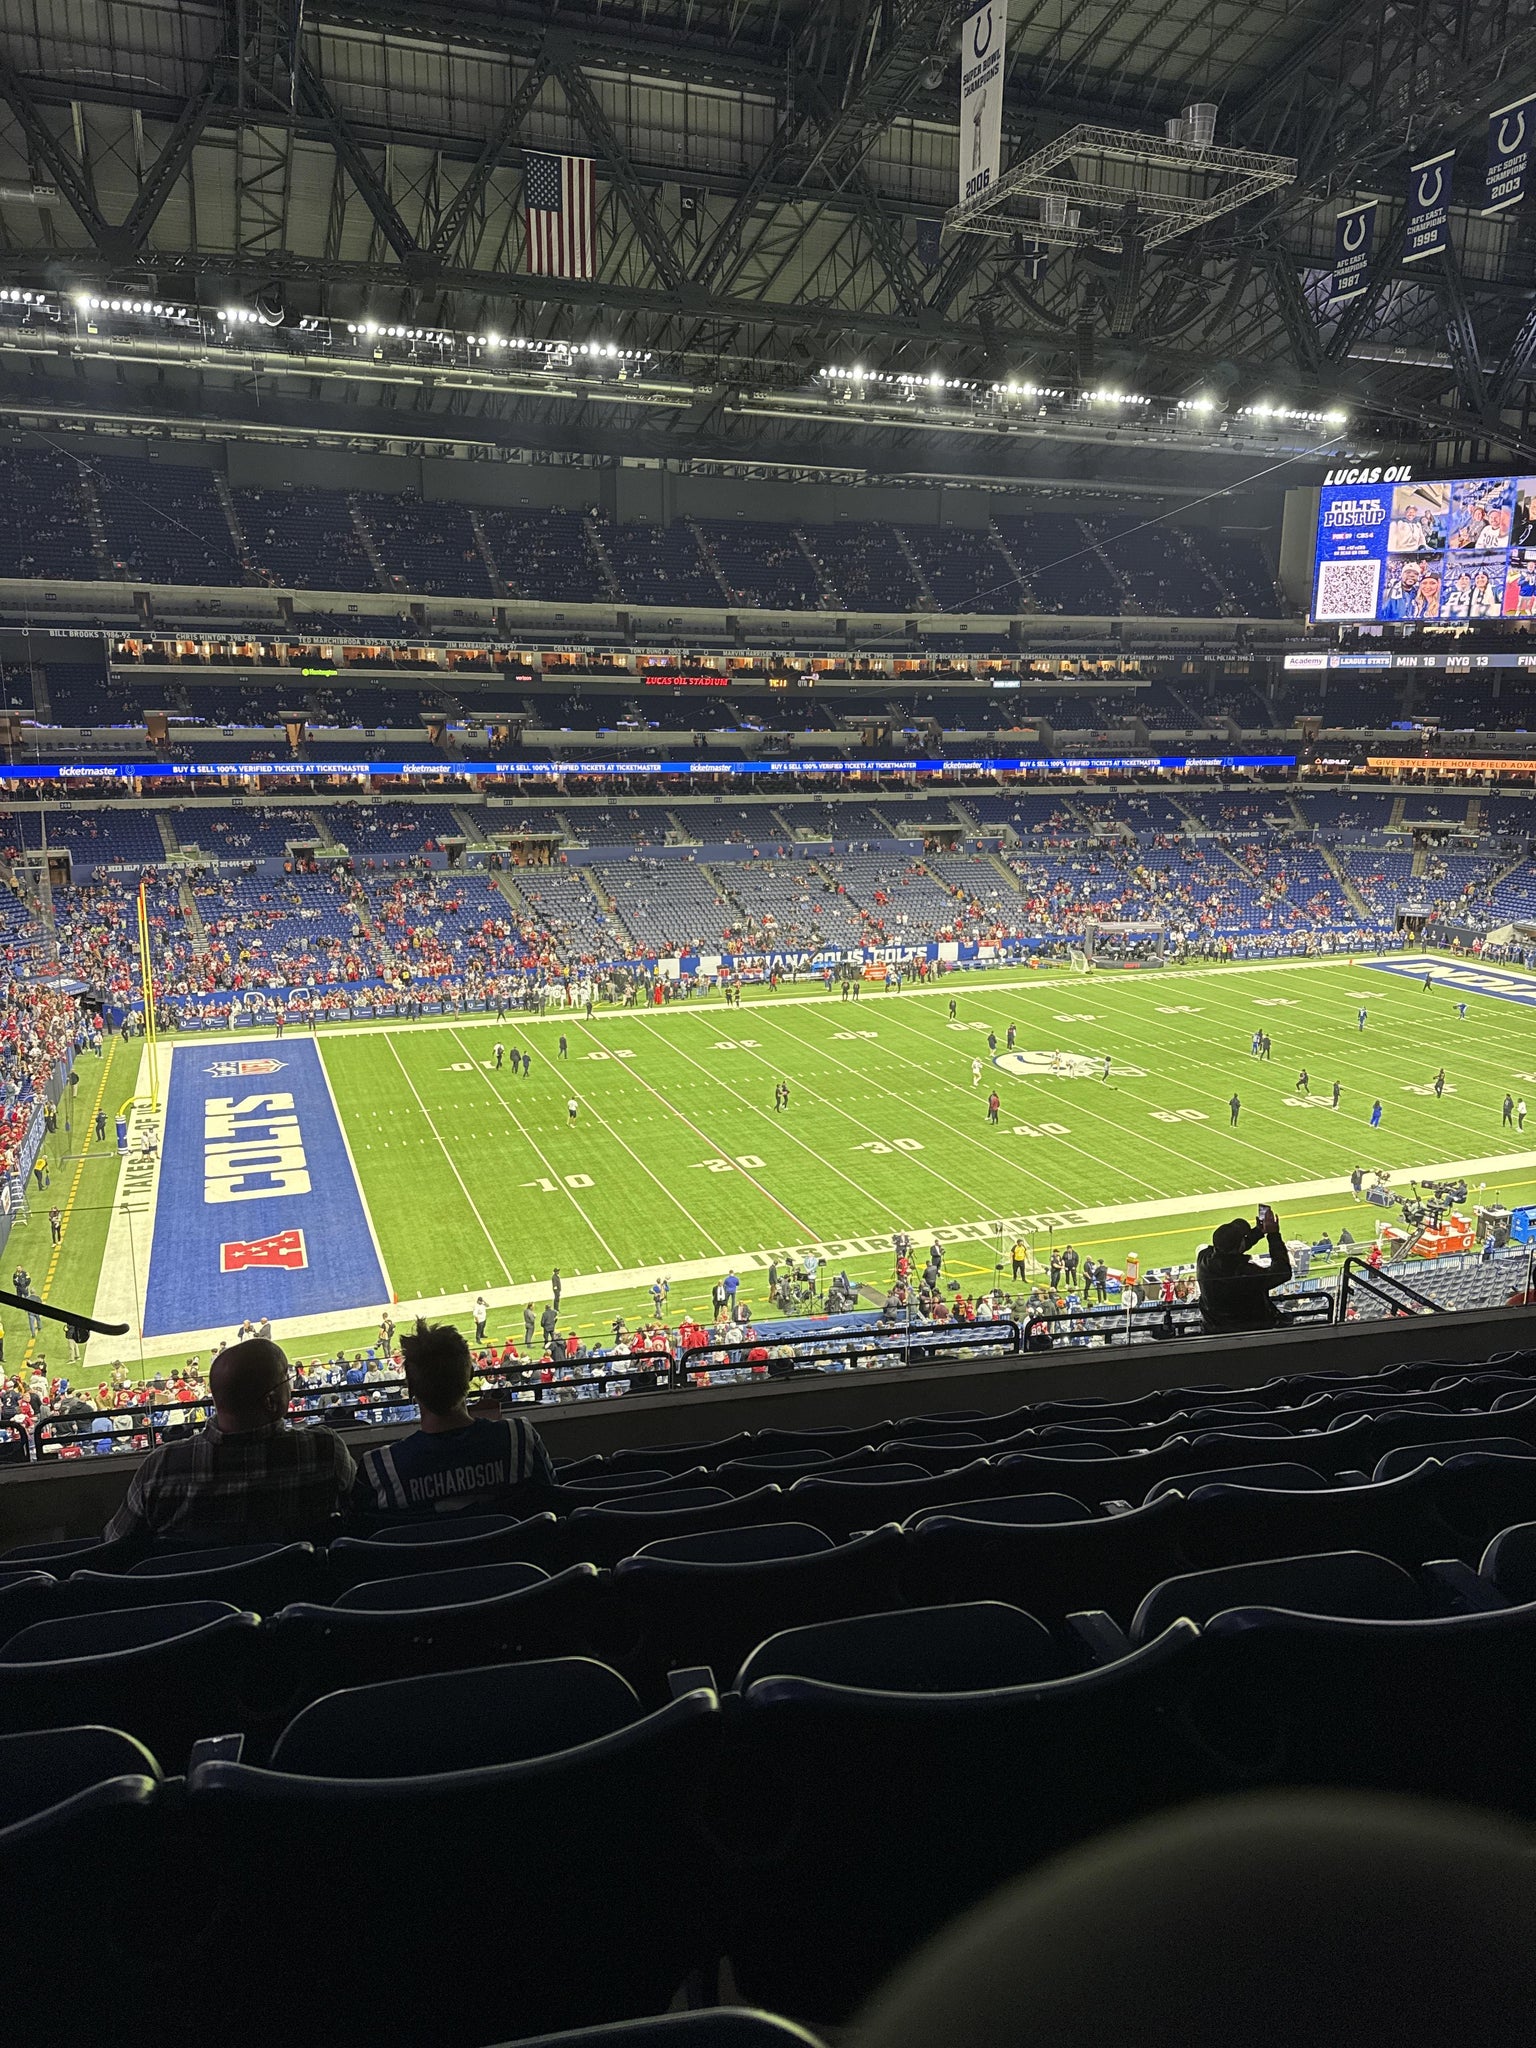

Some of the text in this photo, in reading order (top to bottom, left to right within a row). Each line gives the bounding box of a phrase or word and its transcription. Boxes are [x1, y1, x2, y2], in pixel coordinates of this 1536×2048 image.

[963, 49, 1001, 86] SUPER BOWL
[963, 63, 1000, 99] CHAMPIONS
[1488, 166, 1501, 177] AFC
[965, 168, 990, 198] 2006
[1491, 177, 1521, 199] 2003
[1411, 207, 1444, 226] AFC EAST
[1406, 215, 1447, 235] CHAMPIONS
[1412, 230, 1438, 249] 1999
[1336, 253, 1366, 268] AFC EAST
[1337, 273, 1360, 290] 1987
[1323, 465, 1412, 486] LUCAS OIL
[1331, 498, 1381, 513] COLTS
[1323, 508, 1386, 528] POSTUP
[49, 630, 68, 638] BILL
[102, 631, 131, 639] 1986-92
[176, 633, 198, 641] CHRIS
[446, 641, 458, 649] JIM
[553, 645, 571, 653] COLTS
[1290, 657, 1323, 666] Academy
[1396, 657, 1418, 667] MIN
[1475, 657, 1489, 666] 13
[645, 677, 729, 686] LUCAS OIL STADIUM
[59, 766, 118, 776] ticketmaster
[172, 766, 188, 774] BUY
[238, 765, 273, 773] VERIFIED
[402, 765, 451, 773] ticketmaster
[690, 764, 732, 772] ticketmaster
[943, 761, 983, 769] ticketmaster
[1400, 759, 1427, 767] STYLE
[1451, 760, 1477, 768] HOME
[1480, 761, 1507, 769] FIELD
[1148, 1108, 1210, 1123] 50
[134, 1118, 161, 1131] OF
[1012, 1122, 1072, 1137] 40
[204, 1092, 313, 1204] COLTS
[864, 1136, 925, 1155] 30
[702, 1154, 768, 1174] 20
[122, 1157, 156, 1197] TAKES
[535, 1173, 596, 1193] 10
[119, 1201, 151, 1216] IT
[931, 1212, 1091, 1242] CHANGE
[1462, 1235, 1473, 1248] G
[409, 1459, 504, 1501] RICHARDSON
